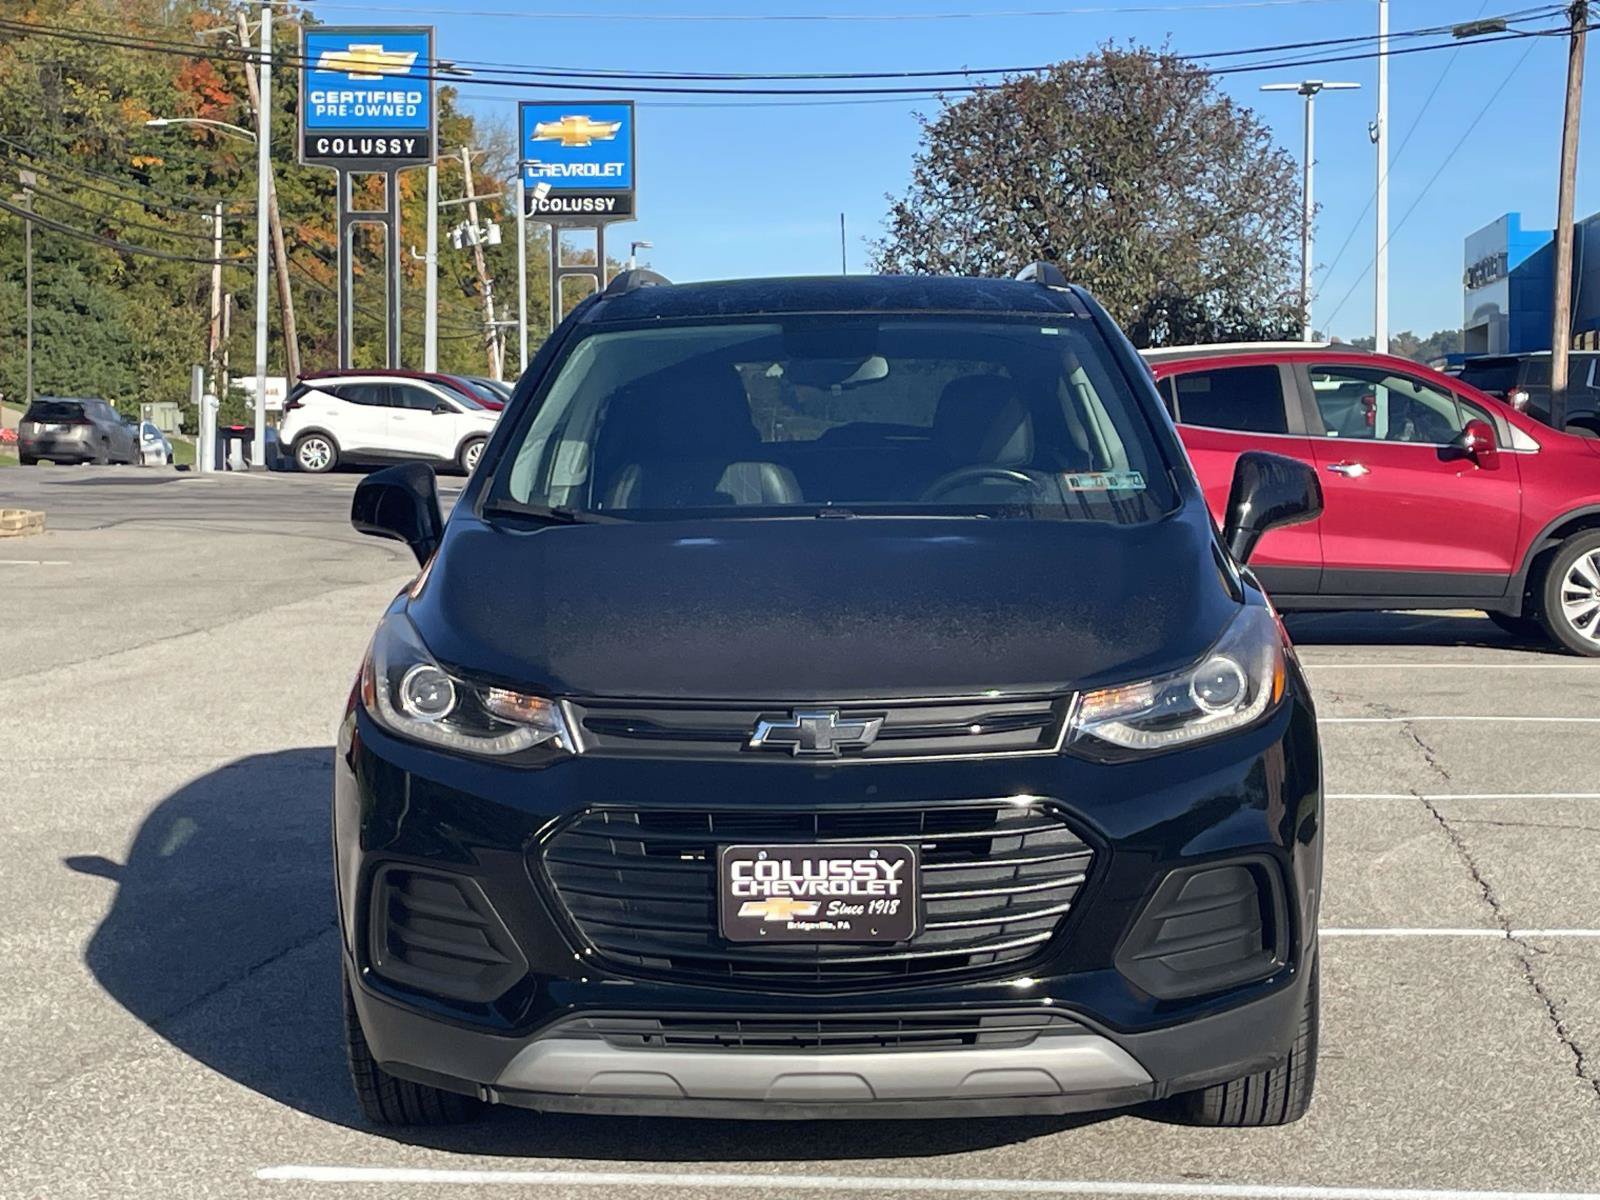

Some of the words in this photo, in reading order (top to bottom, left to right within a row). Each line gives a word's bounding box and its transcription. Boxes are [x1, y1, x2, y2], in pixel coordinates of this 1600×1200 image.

[310, 91, 422, 104] CERTIFIED
[316, 104, 417, 117] PRE-OWNED
[317, 138, 416, 154] COLUSSY
[538, 198, 615, 212] COLUSSY
[731, 859, 904, 880] COLUSSY
[731, 880, 903, 896] CHEVROLET
[826, 900, 864, 916] Since
[868, 900, 900, 914] 1918
